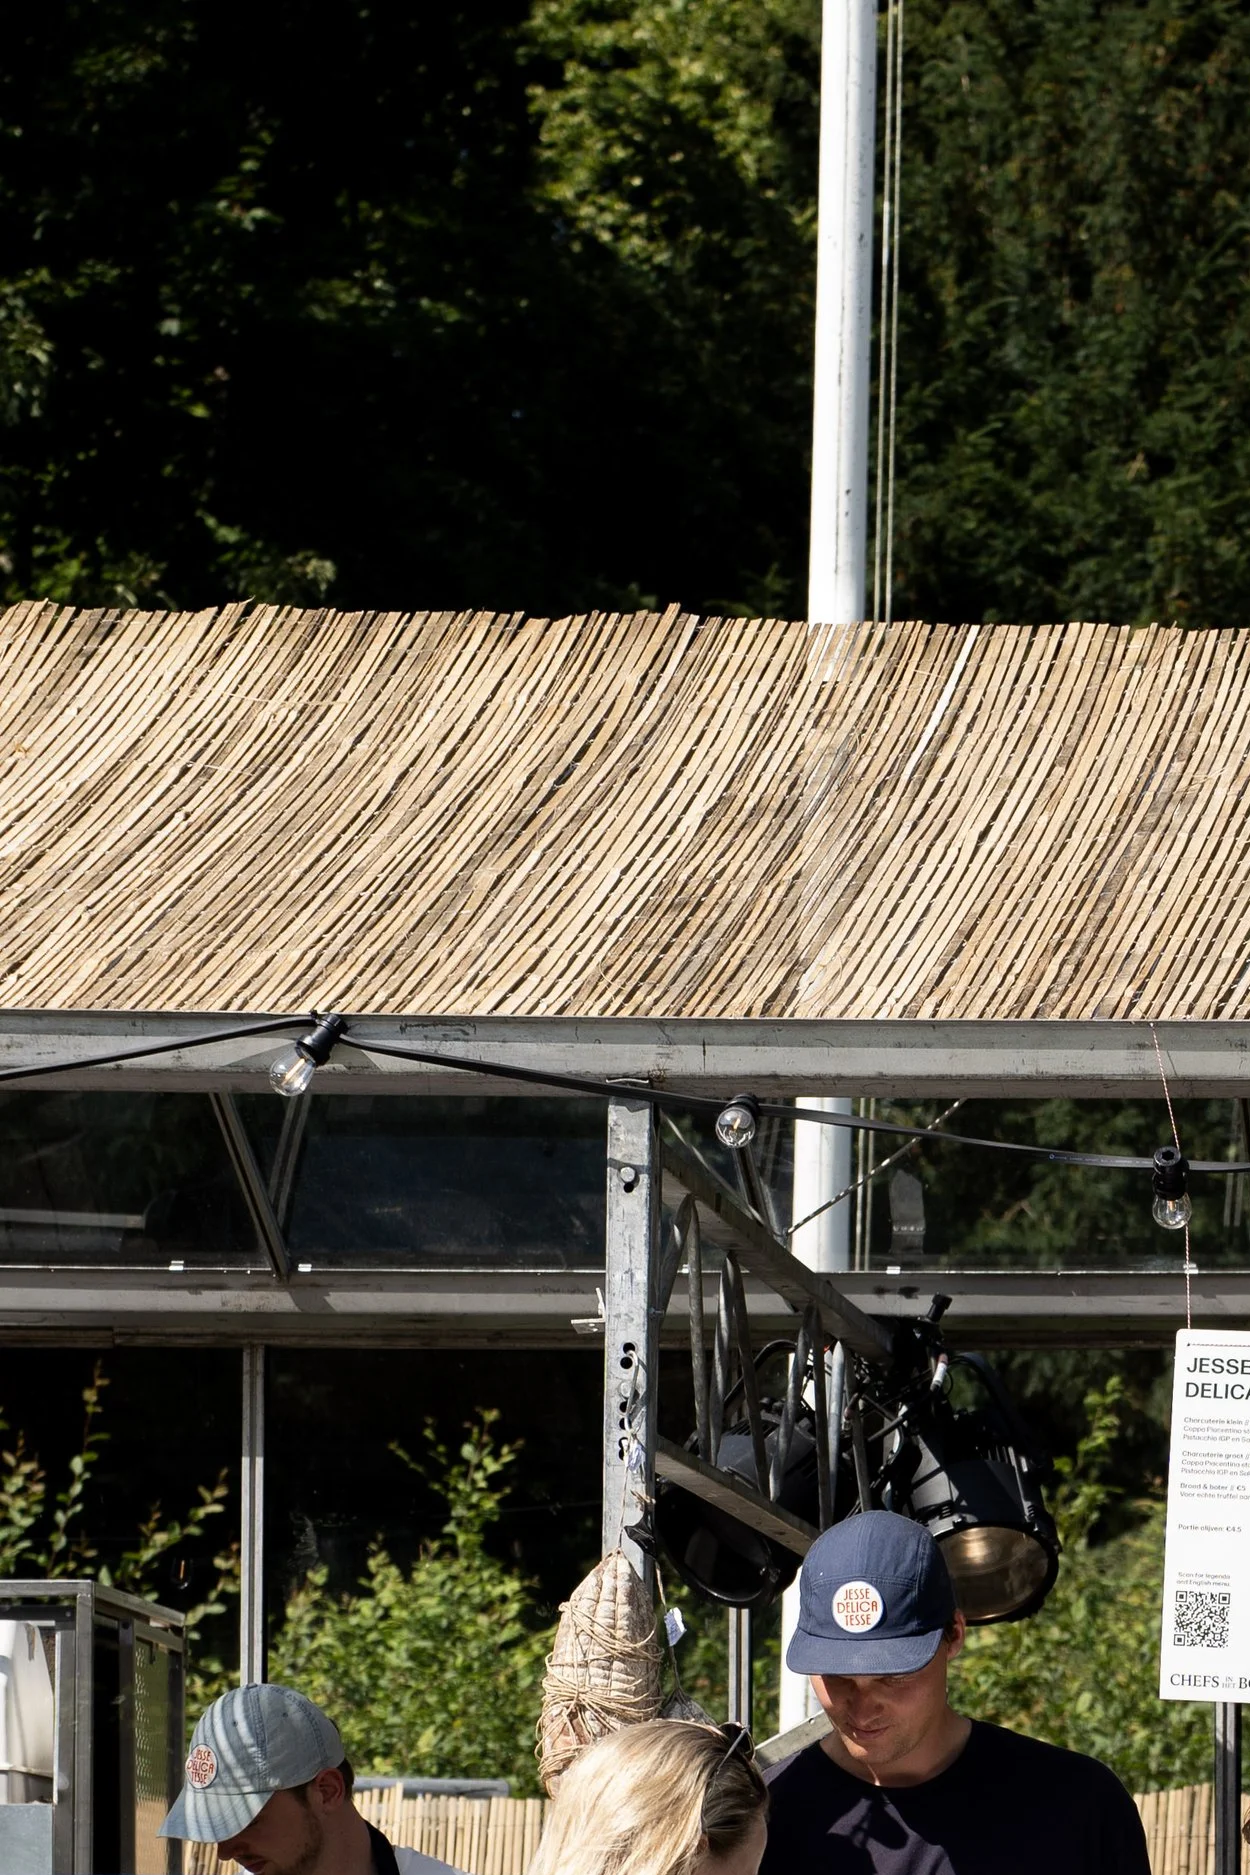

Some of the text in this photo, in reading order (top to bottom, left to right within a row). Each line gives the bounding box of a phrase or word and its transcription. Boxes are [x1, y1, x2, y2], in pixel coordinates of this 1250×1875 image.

[1184, 1417, 1225, 1425] Charcuterie
[1226, 1418, 1243, 1426] klein
[1183, 1425, 1205, 1434] Coppa
[1182, 1434, 1217, 1442] Pistacchio
[1182, 1450, 1223, 1459] Charcuterie
[1181, 1459, 1204, 1467] Coppa
[1181, 1467, 1216, 1476] Pistacchio
[843, 1588, 870, 1601] JESSE
[837, 1600, 878, 1614] DELICA
[845, 1614, 871, 1626] TESSE
[1170, 1673, 1220, 1688] CHEFS
[186, 1759, 214, 1774] DELICA
